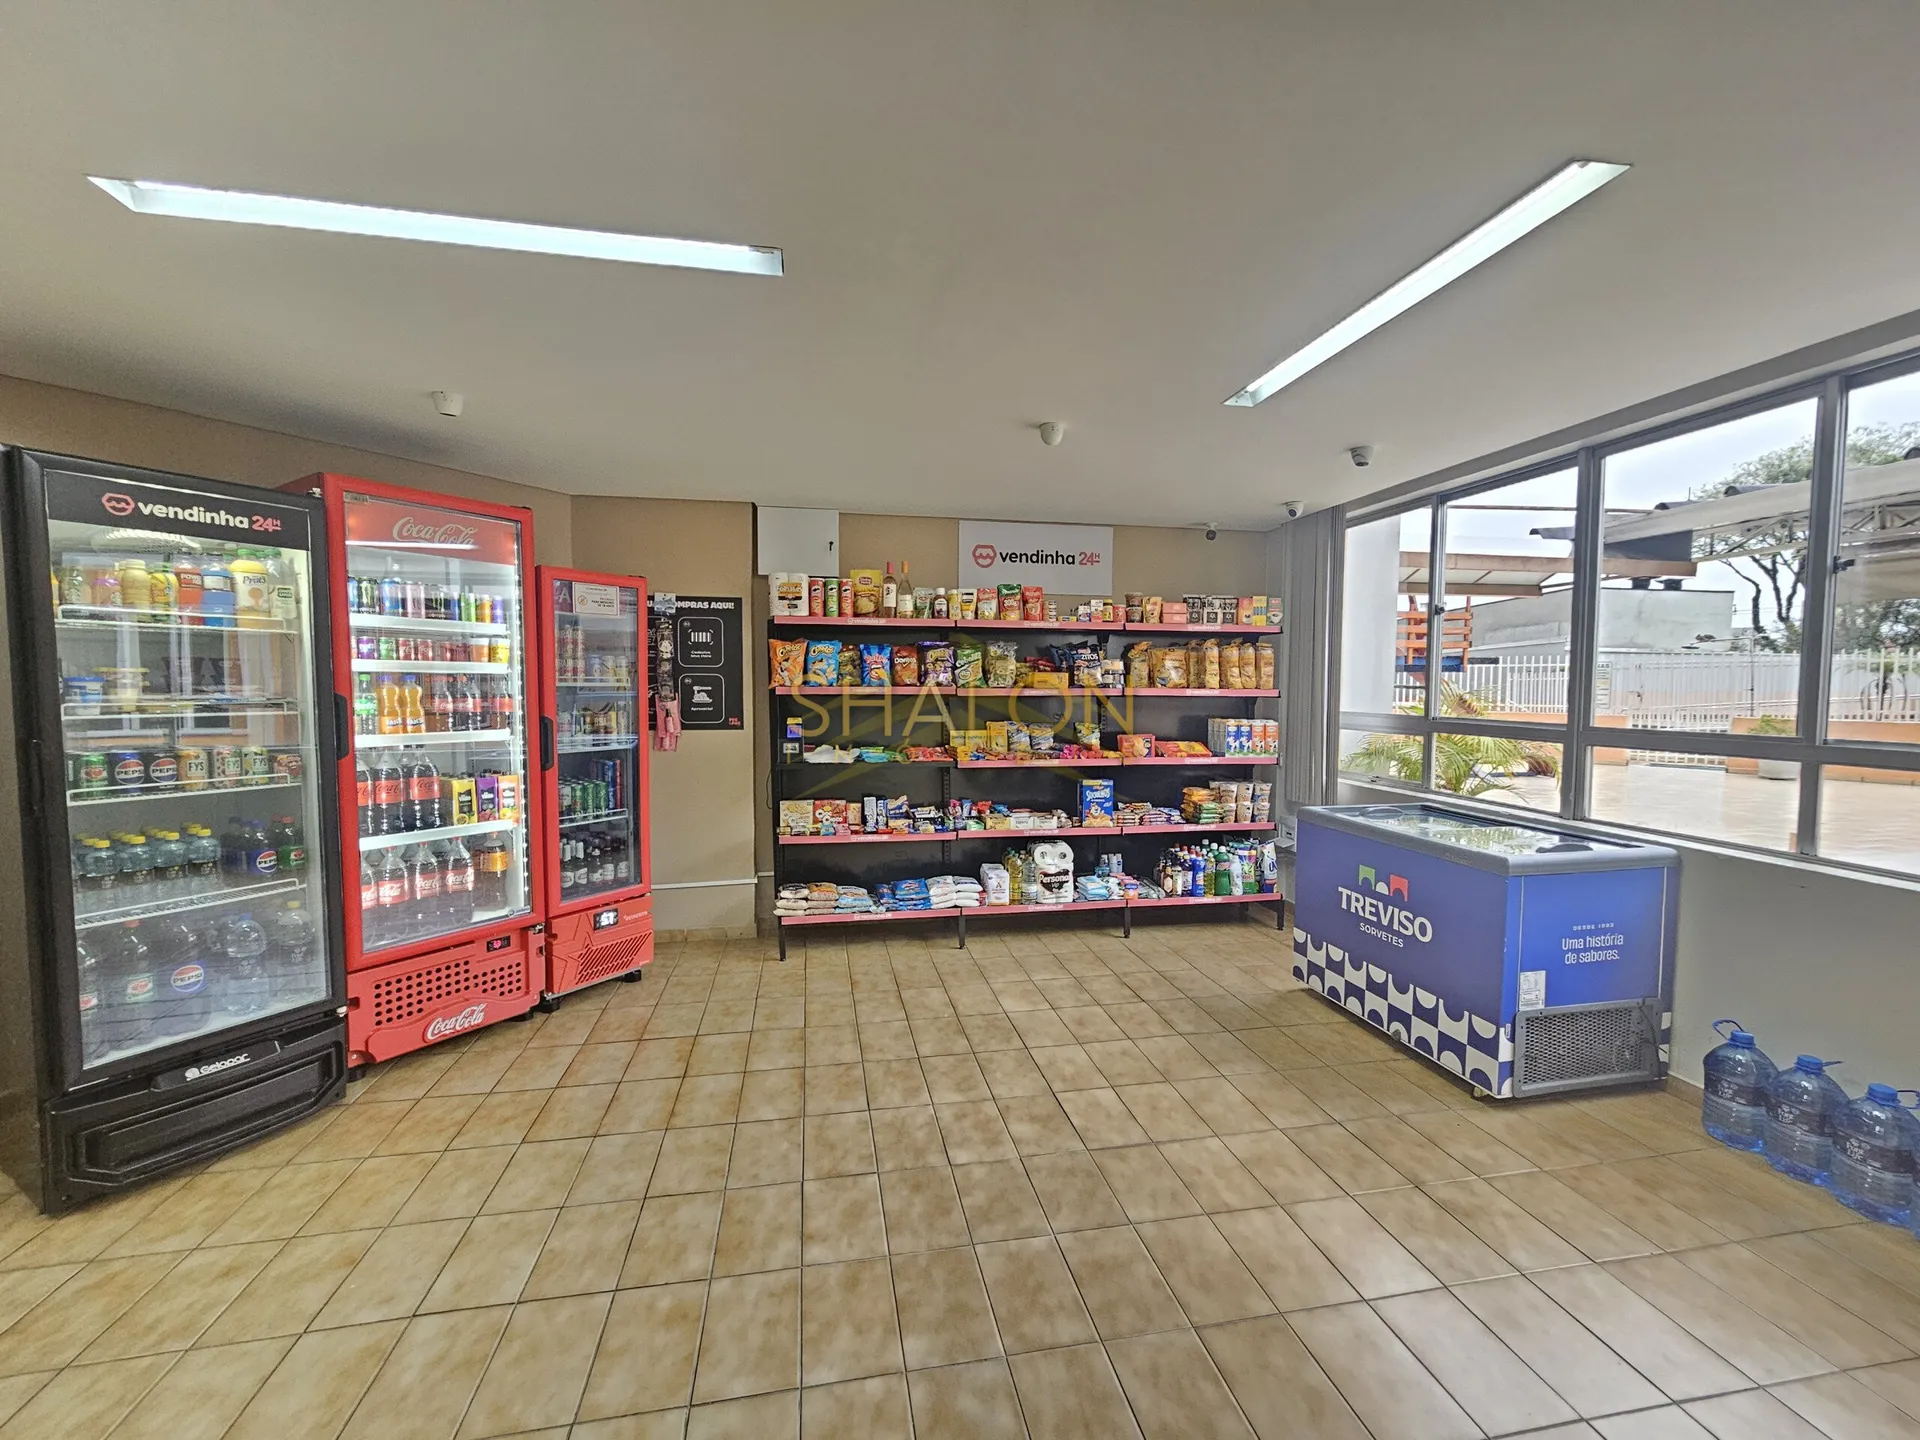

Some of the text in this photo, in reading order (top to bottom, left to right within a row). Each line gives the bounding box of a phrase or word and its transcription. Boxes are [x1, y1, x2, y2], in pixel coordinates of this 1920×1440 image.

[137, 501, 249, 529] vendinha
[999, 550, 1076, 565] vendinha
[675, 600, 709, 609] MPRAS
[188, 761, 204, 772] FYS
[226, 759, 240, 770] FYS
[252, 757, 267, 767] FYS
[1338, 886, 1433, 943] TREVISO
[1359, 922, 1404, 948] SORVETES
[1562, 932, 1624, 950] Uma história
[1565, 949, 1620, 965] de sabores.
[426, 1003, 488, 1040] Coca-Cola
